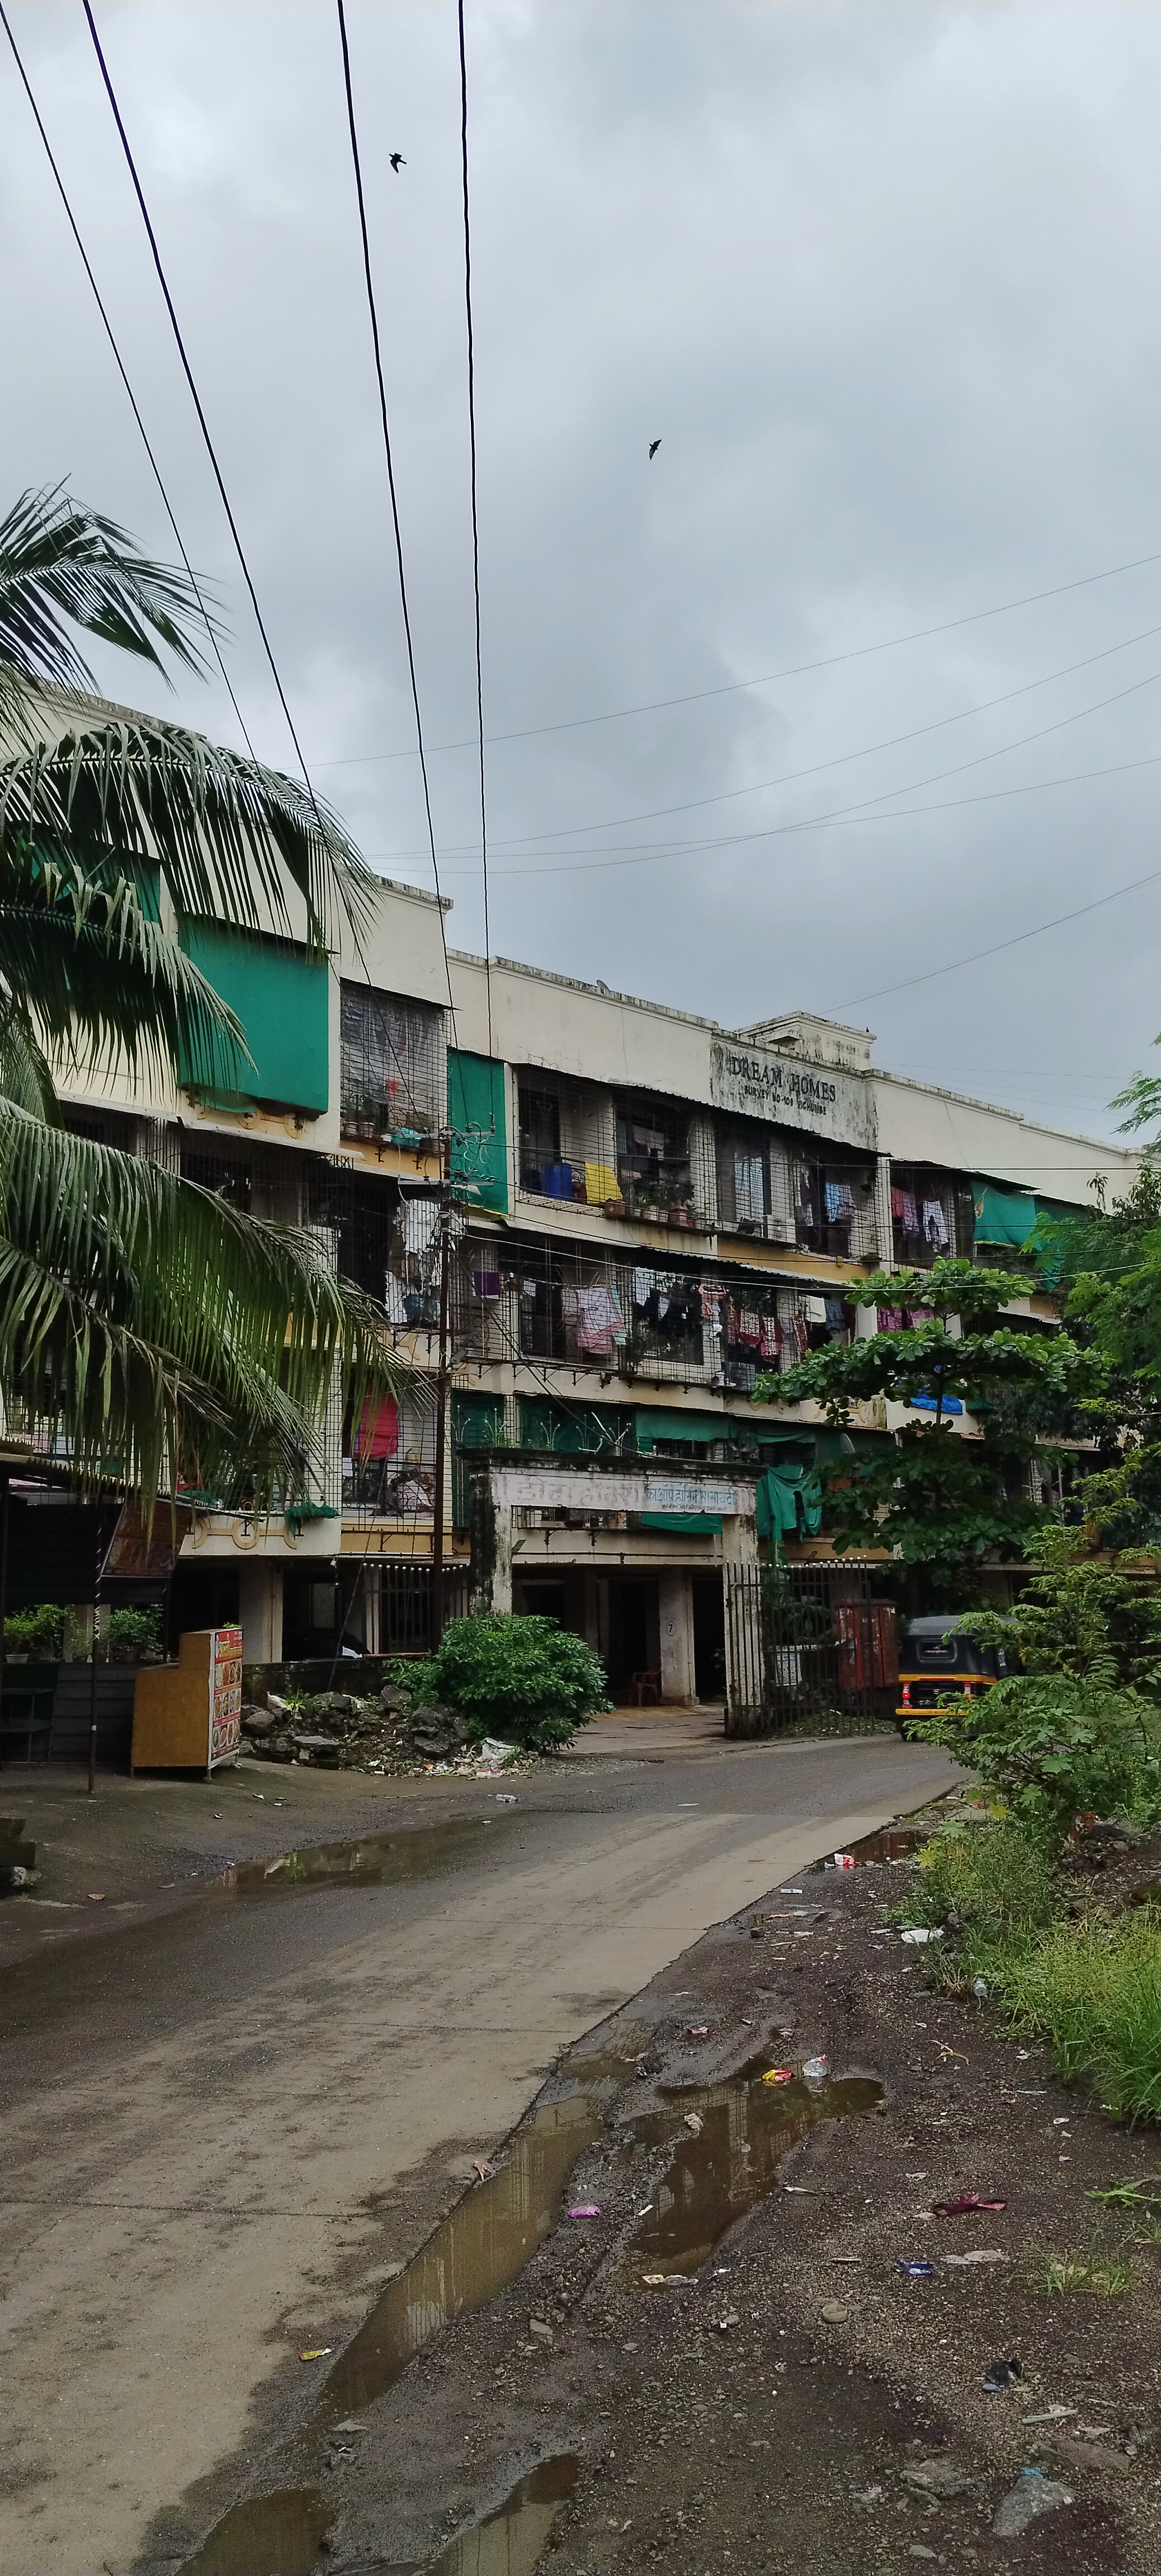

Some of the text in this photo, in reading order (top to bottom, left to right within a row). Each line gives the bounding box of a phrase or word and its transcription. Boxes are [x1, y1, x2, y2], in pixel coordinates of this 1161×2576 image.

[731, 1057, 836, 1101] DREAM HOMES
[744, 1085, 770, 1100] SURVEY
[797, 1100, 827, 1115] VICHUMBE
[668, 1624, 673, 1633] 7
